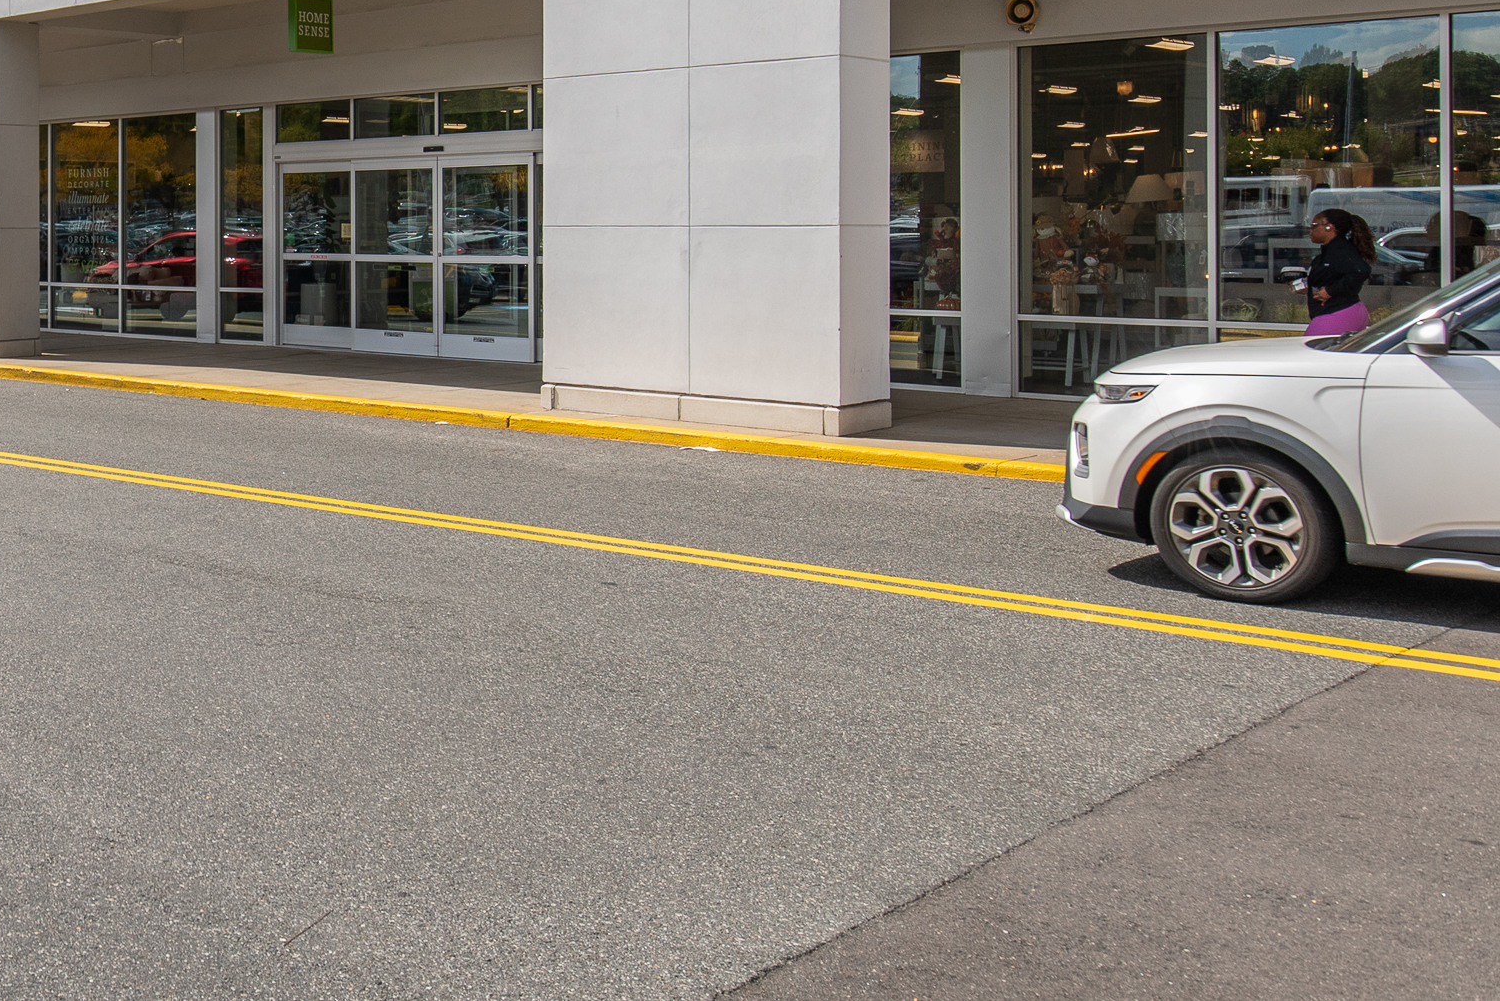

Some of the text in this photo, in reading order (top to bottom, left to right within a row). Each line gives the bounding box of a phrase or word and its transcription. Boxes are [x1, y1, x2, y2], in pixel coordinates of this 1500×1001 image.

[298, 11, 330, 24] HOME
[298, 25, 330, 38] SENSE
[68, 168, 110, 178] FURNISH
[68, 190, 110, 204] illuminate
[68, 236, 110, 244] ORGANIZE
[67, 247, 110, 255] IMPROE
